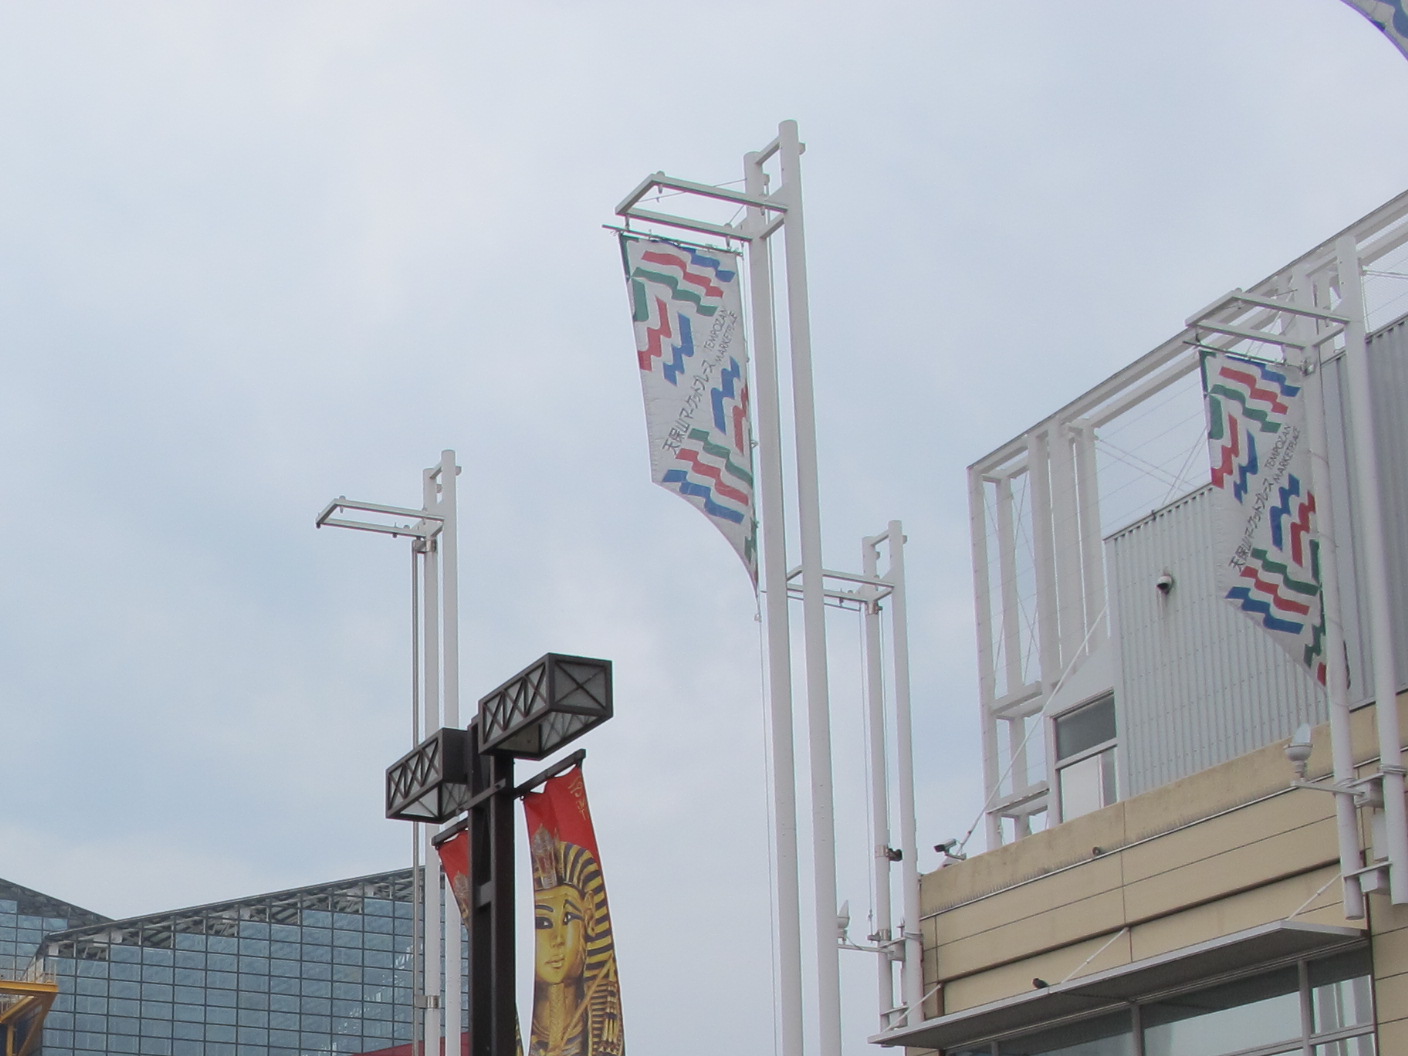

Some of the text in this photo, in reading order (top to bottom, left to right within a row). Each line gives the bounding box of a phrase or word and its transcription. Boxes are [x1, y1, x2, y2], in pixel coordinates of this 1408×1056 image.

[703, 307, 729, 353] TEMPOZAN
[661, 359, 716, 456] 天保山マーケットプレース
[1264, 424, 1292, 470] TEMPOZAN
